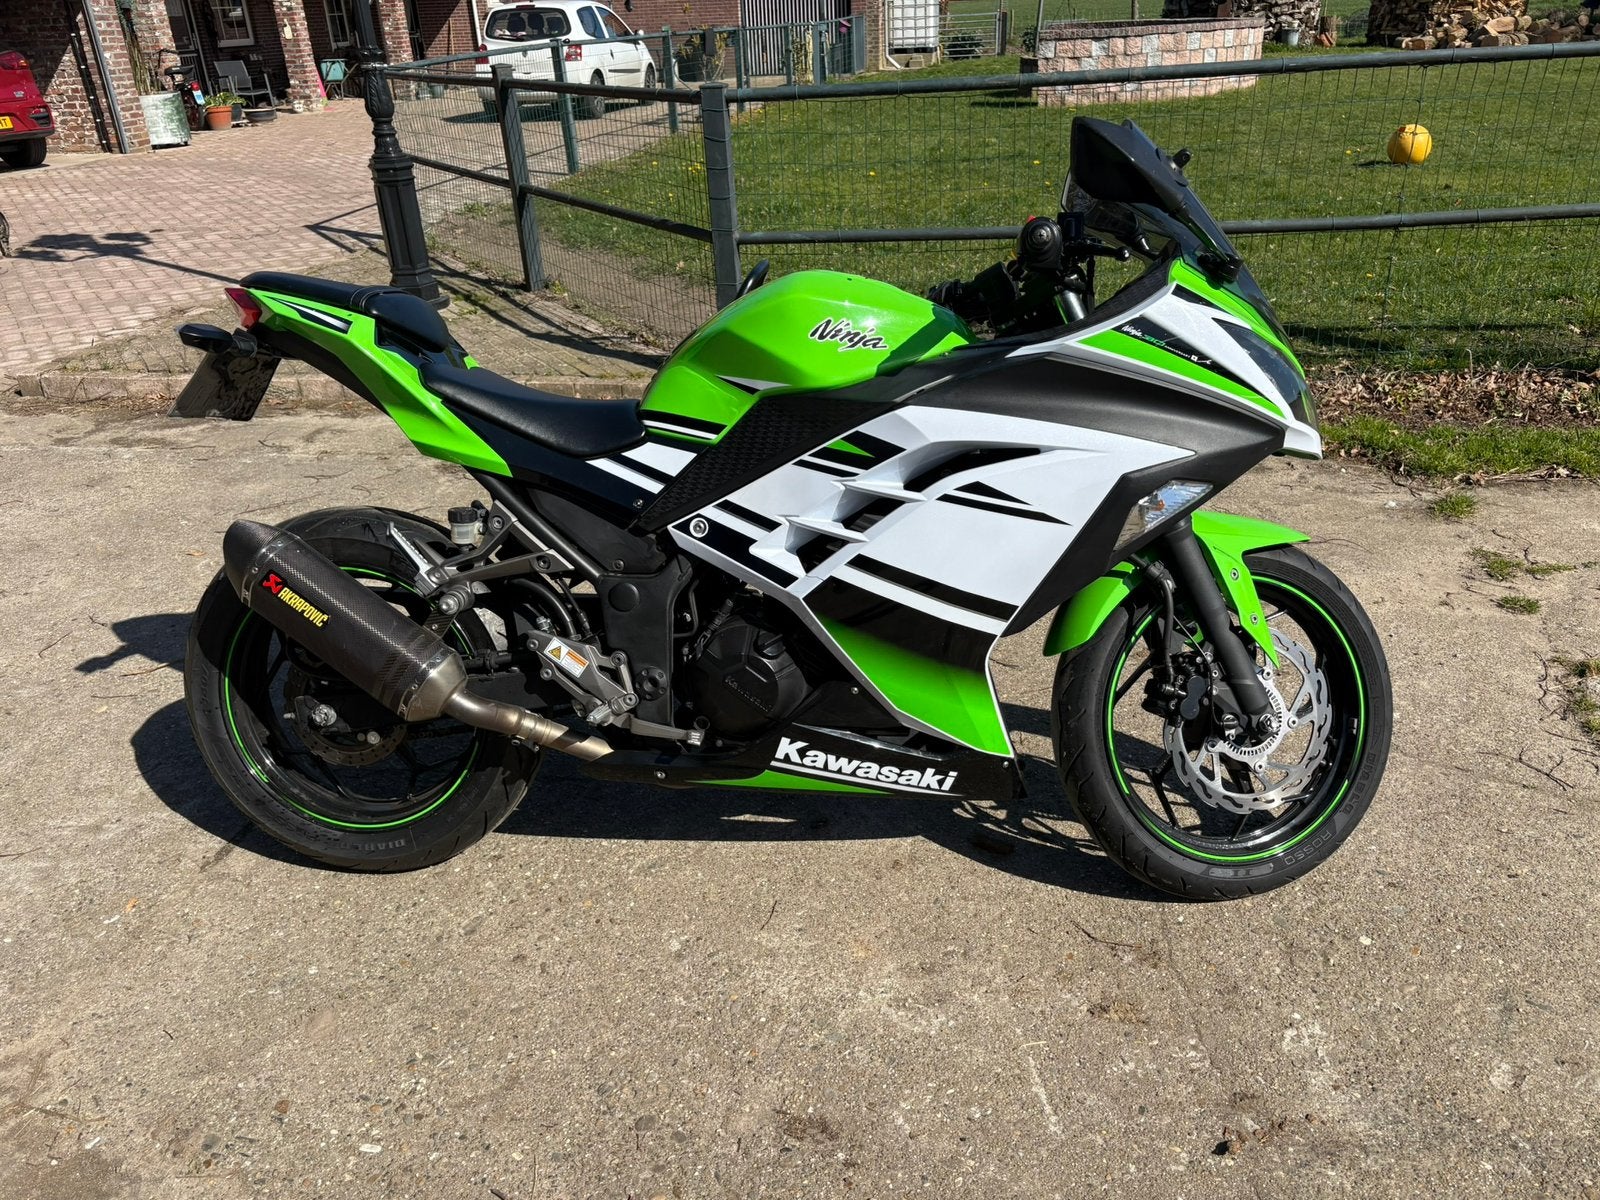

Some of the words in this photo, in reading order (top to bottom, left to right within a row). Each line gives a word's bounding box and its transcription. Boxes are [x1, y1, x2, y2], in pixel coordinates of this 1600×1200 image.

[808, 317, 888, 351] Ninja
[775, 736, 958, 791] Kawasaki
[1284, 829, 1333, 866] ROSSO
